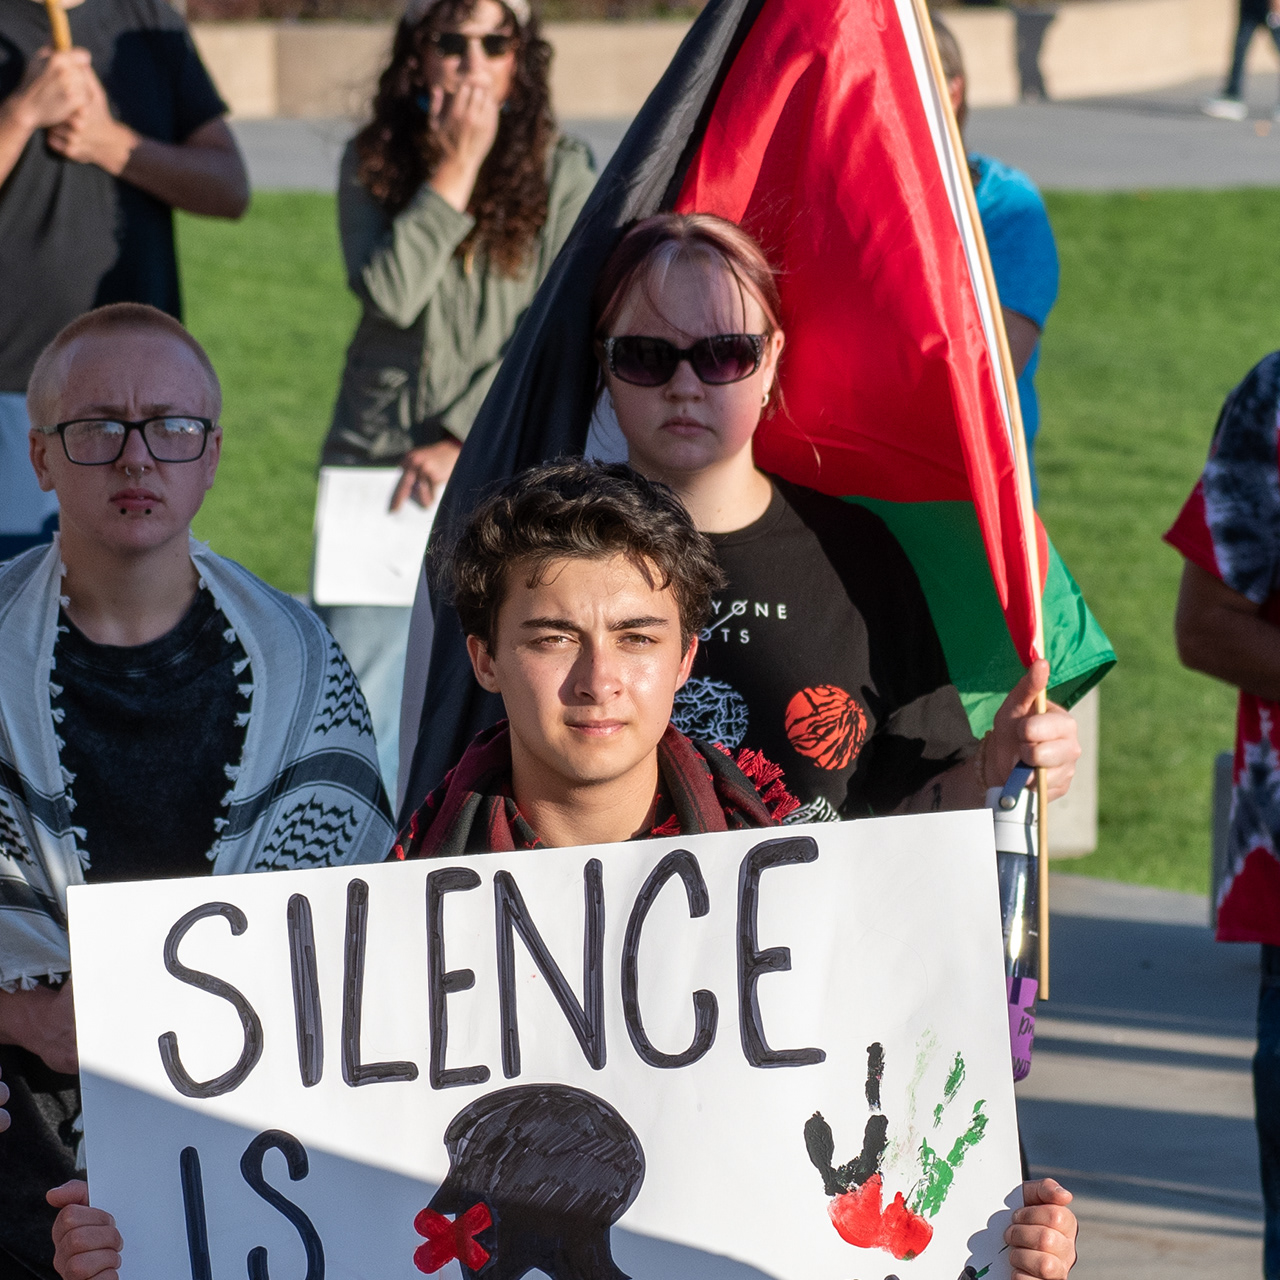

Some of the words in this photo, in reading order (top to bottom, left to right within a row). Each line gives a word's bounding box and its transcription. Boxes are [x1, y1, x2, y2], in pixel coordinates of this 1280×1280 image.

[710, 600, 787, 620] YONE
[698, 627, 751, 645] OTS
[157, 835, 826, 1099] SILENCE
